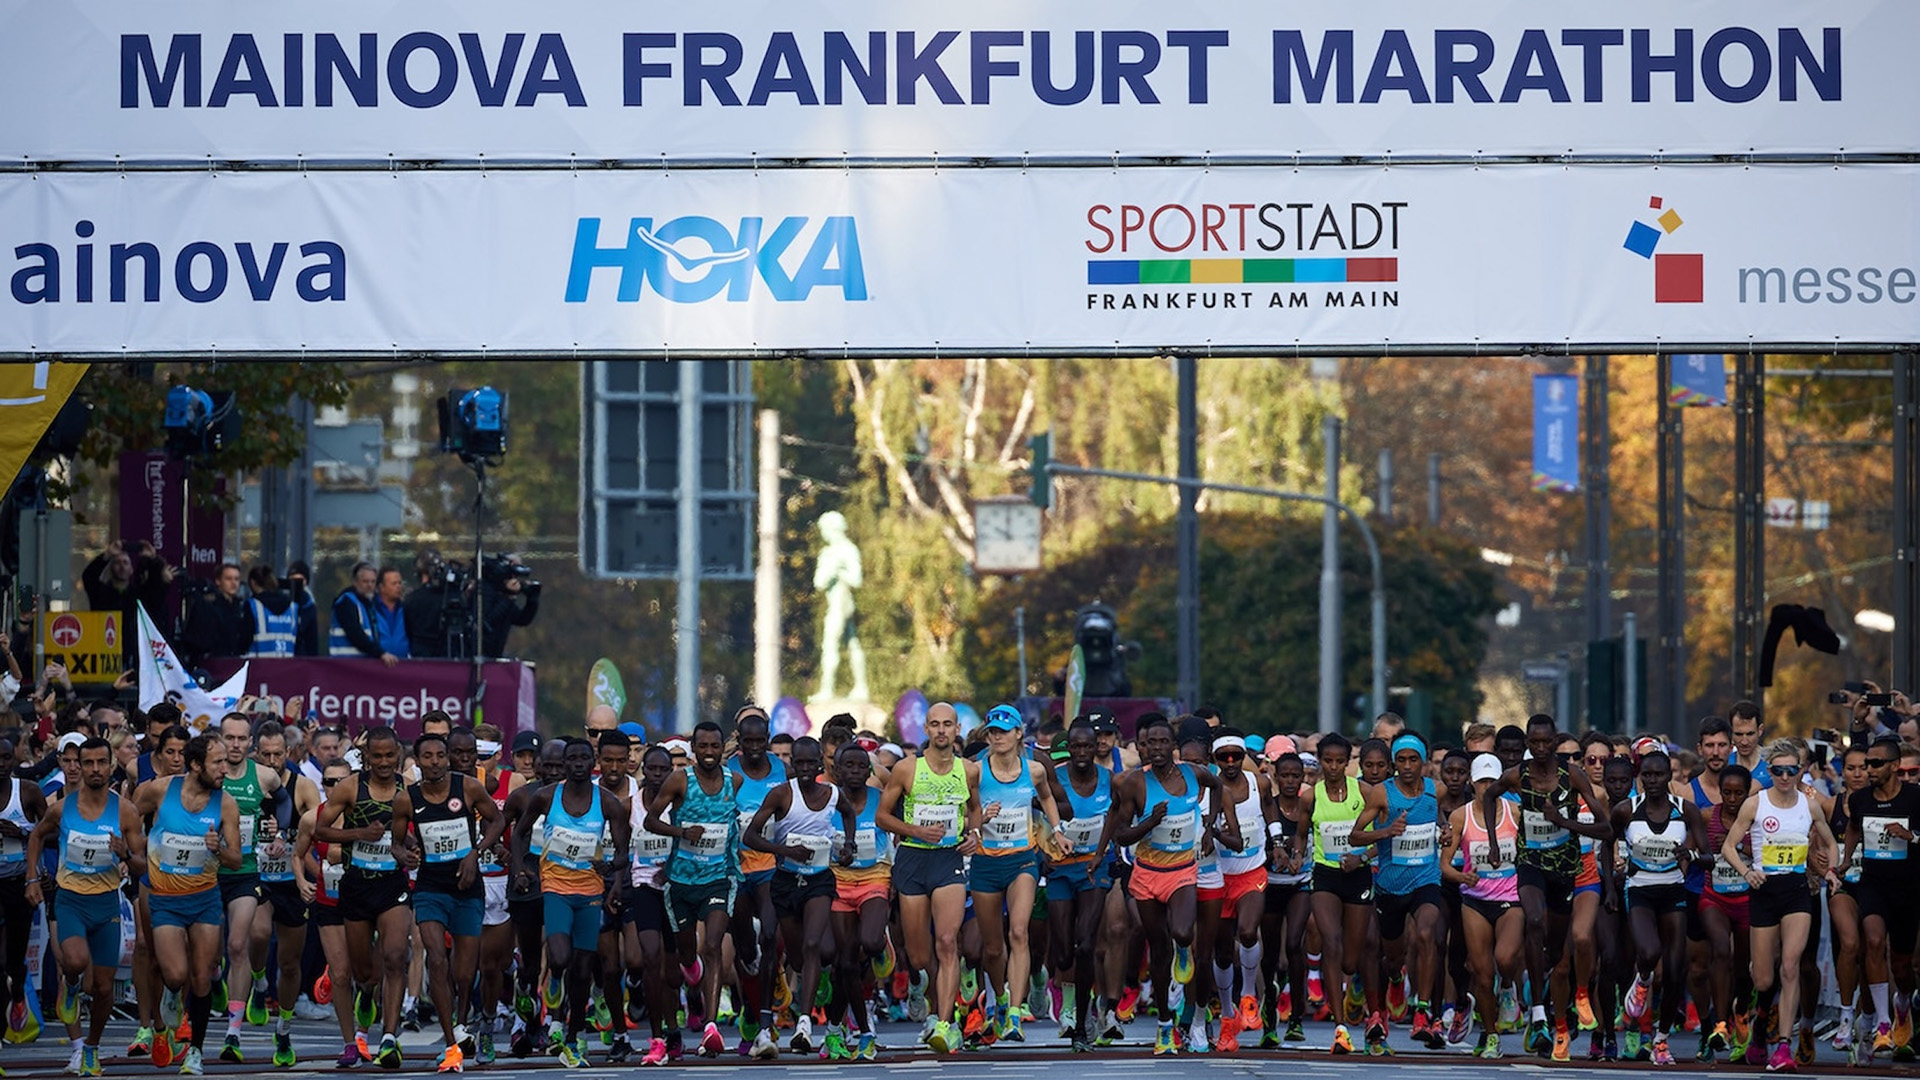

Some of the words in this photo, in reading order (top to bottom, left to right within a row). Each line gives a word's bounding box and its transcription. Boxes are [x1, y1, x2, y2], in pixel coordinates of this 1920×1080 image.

[120, 31, 588, 109] MAINOVA
[622, 29, 1229, 107] FRANKFURT
[1272, 26, 1842, 104] MARATHON
[1085, 202, 1409, 254] SPORTSTADT
[10, 219, 347, 304] ainova
[564, 215, 868, 303] HOKA
[1738, 266, 1917, 304] messe
[1087, 292, 1253, 310] FRANKFURT
[1268, 292, 1309, 308] AM
[1324, 290, 1399, 308] MAIN
[433, 823, 463, 832] mainova
[996, 823, 1015, 834] THEA
[1169, 828, 1182, 839] 45
[1078, 831, 1090, 842] 40
[434, 839, 459, 854] 9597
[566, 844, 580, 856] 48
[1399, 839, 1429, 851] FILIMON
[83, 849, 96, 861] 47
[176, 849, 190, 861] 34
[1778, 852, 1785, 864] 5
[1786, 852, 1793, 864] A
[262, 861, 287, 873] 2828
